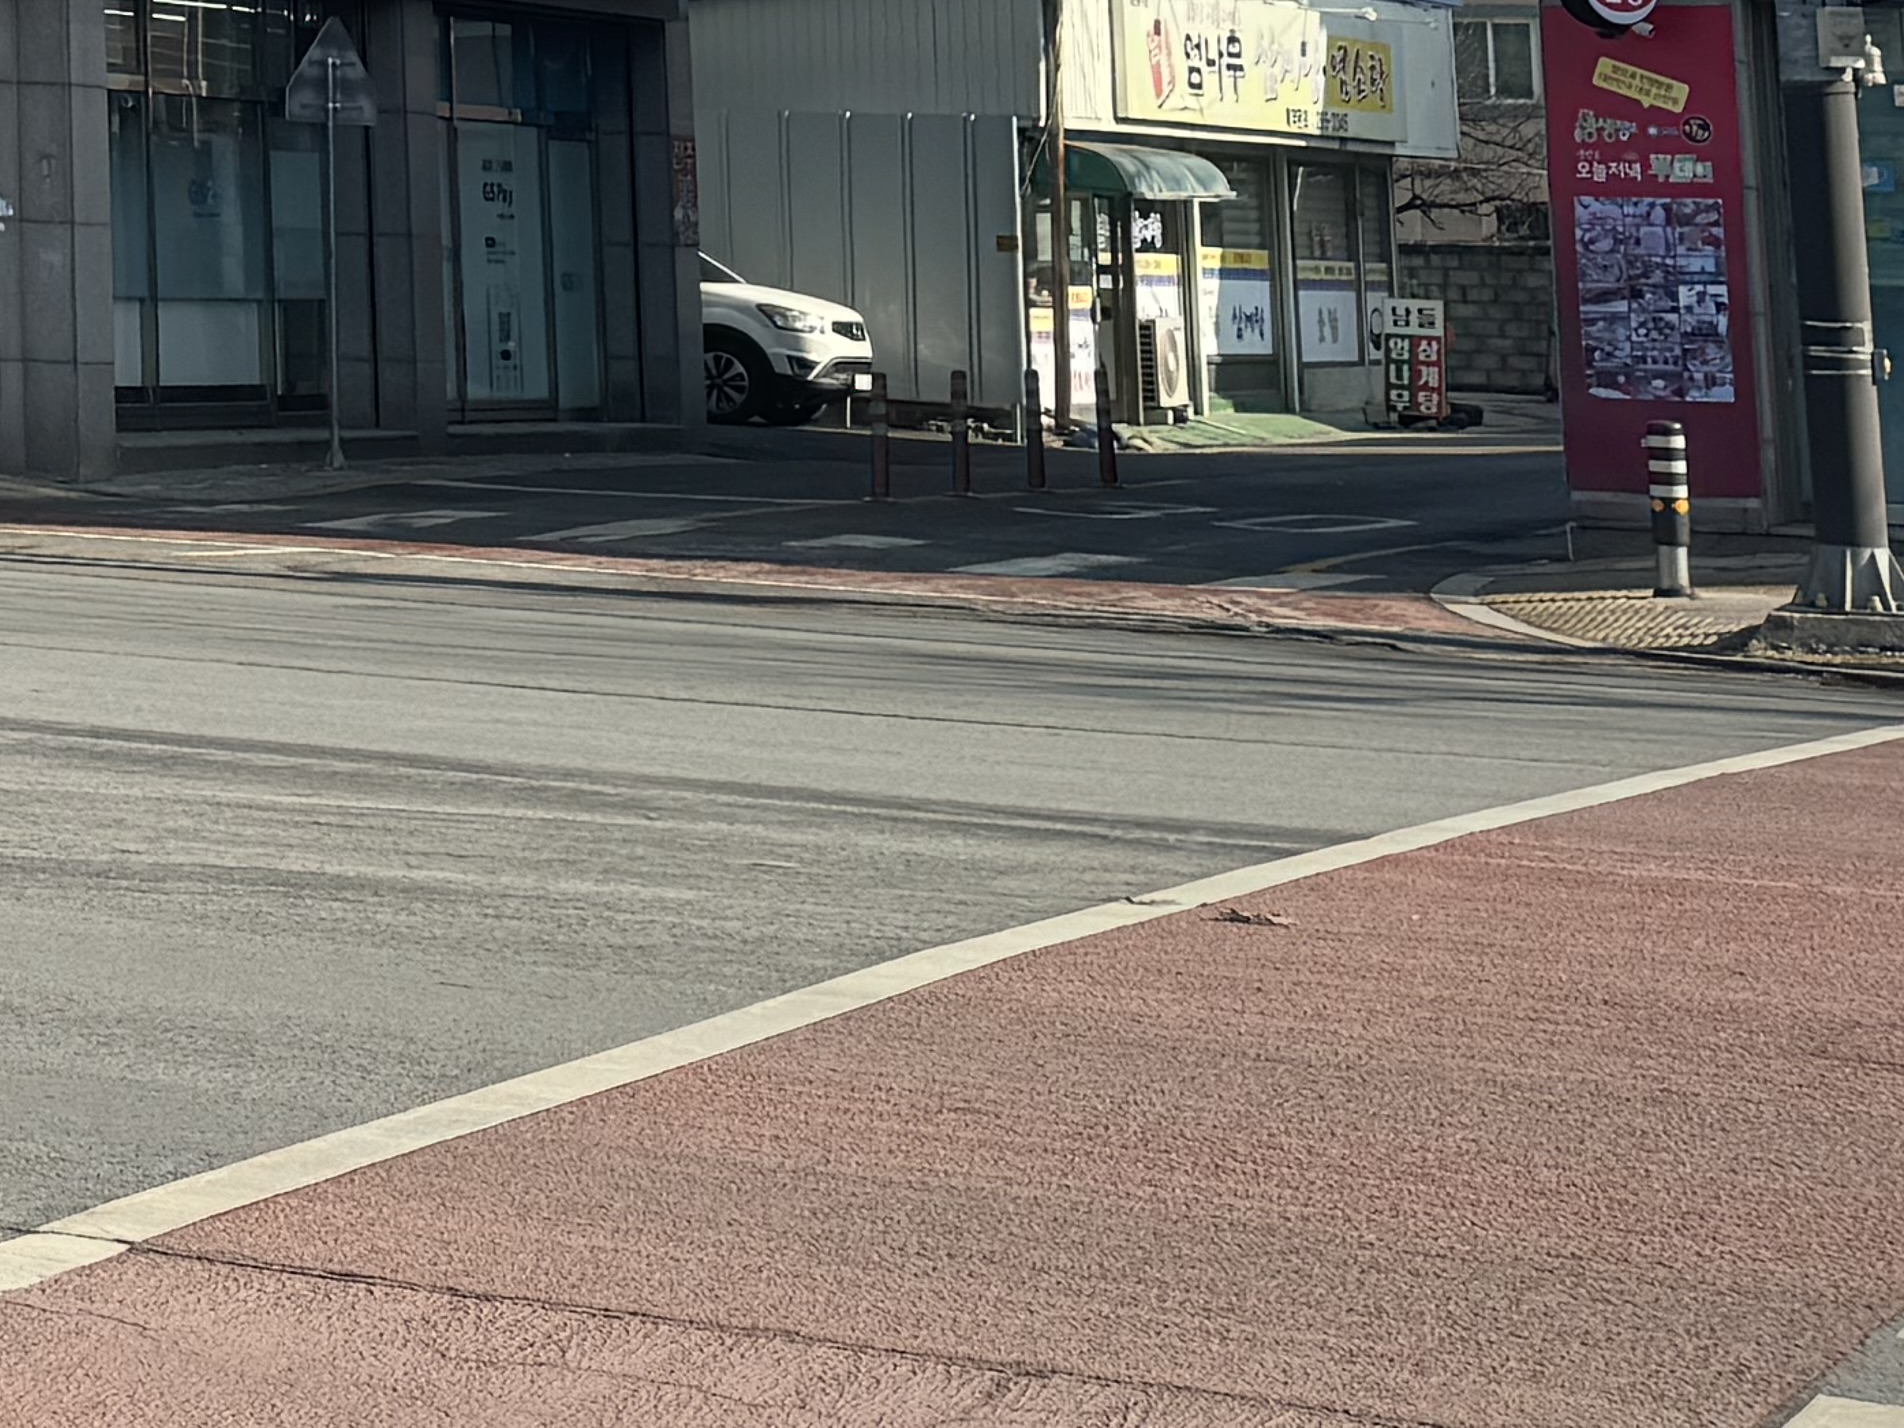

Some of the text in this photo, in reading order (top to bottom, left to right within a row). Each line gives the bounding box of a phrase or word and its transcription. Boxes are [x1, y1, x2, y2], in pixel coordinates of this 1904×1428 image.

[1183, 28, 1246, 103] 엄나무
[1576, 160, 1641, 183] 오늘저녁
[1388, 337, 1411, 412] 엄나무
[1417, 339, 1439, 414] 삼계탕
